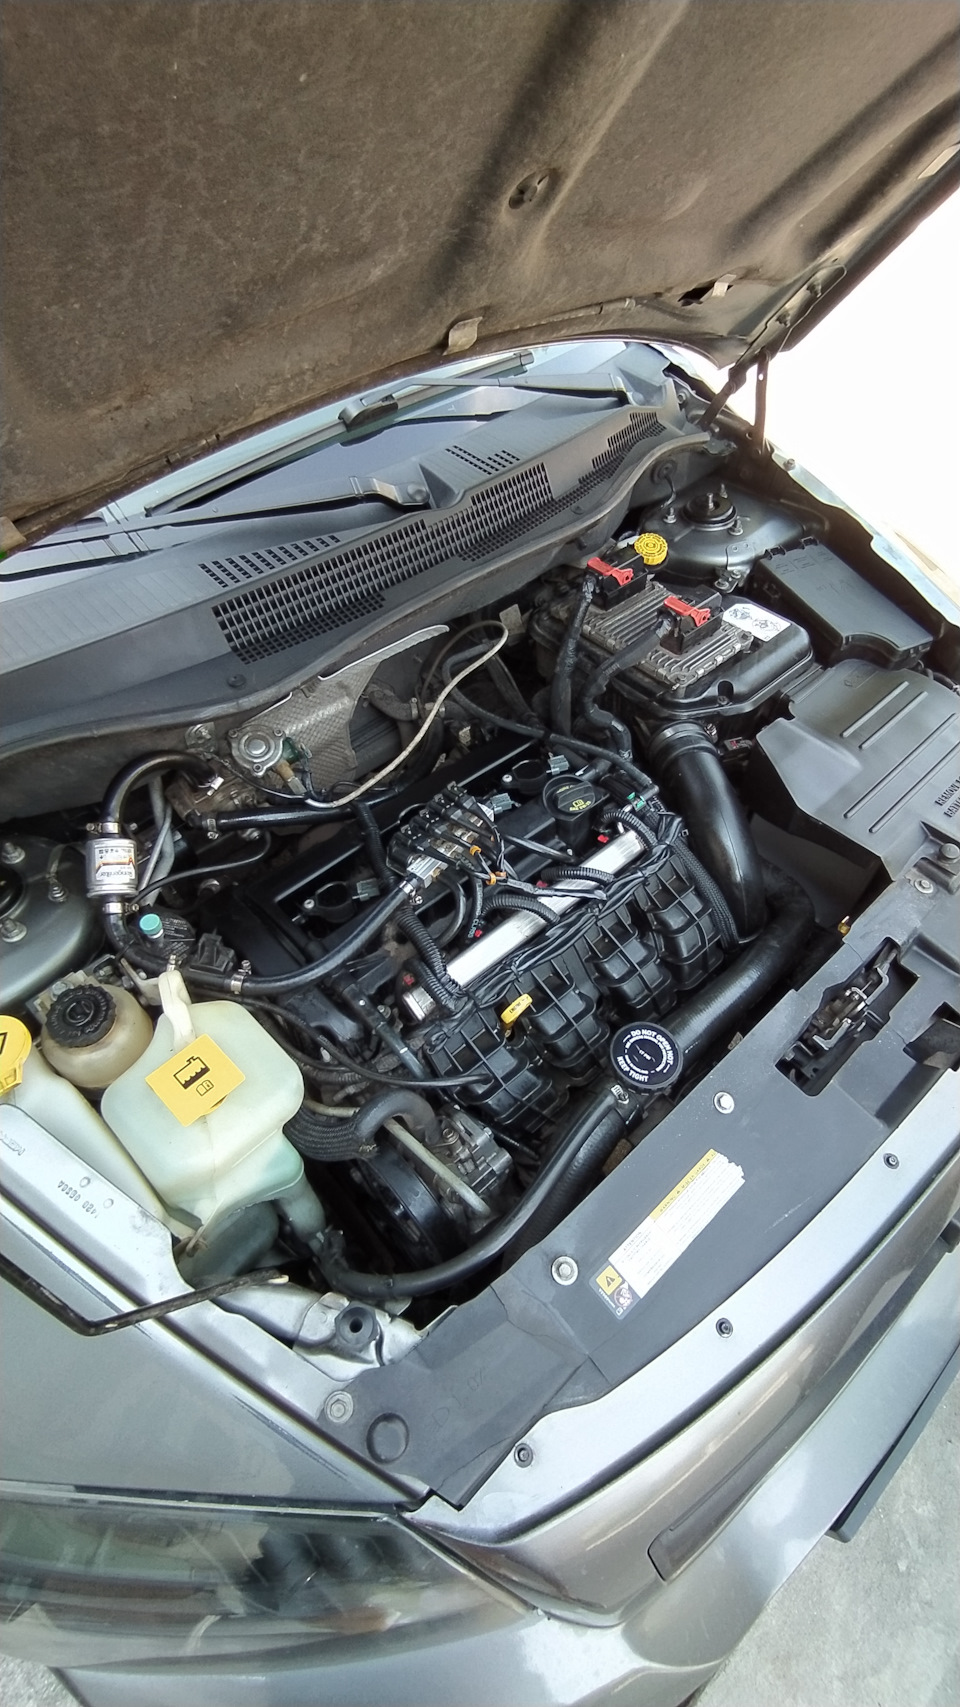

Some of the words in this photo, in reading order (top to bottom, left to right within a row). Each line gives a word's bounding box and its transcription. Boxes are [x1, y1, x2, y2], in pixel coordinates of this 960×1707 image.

[630, 1029, 642, 1037] DO
[641, 1028, 657, 1038] NOT
[655, 1034, 672, 1051] OPEN
[616, 1055, 631, 1072] KEEP
[628, 1069, 649, 1083] TIGHT
